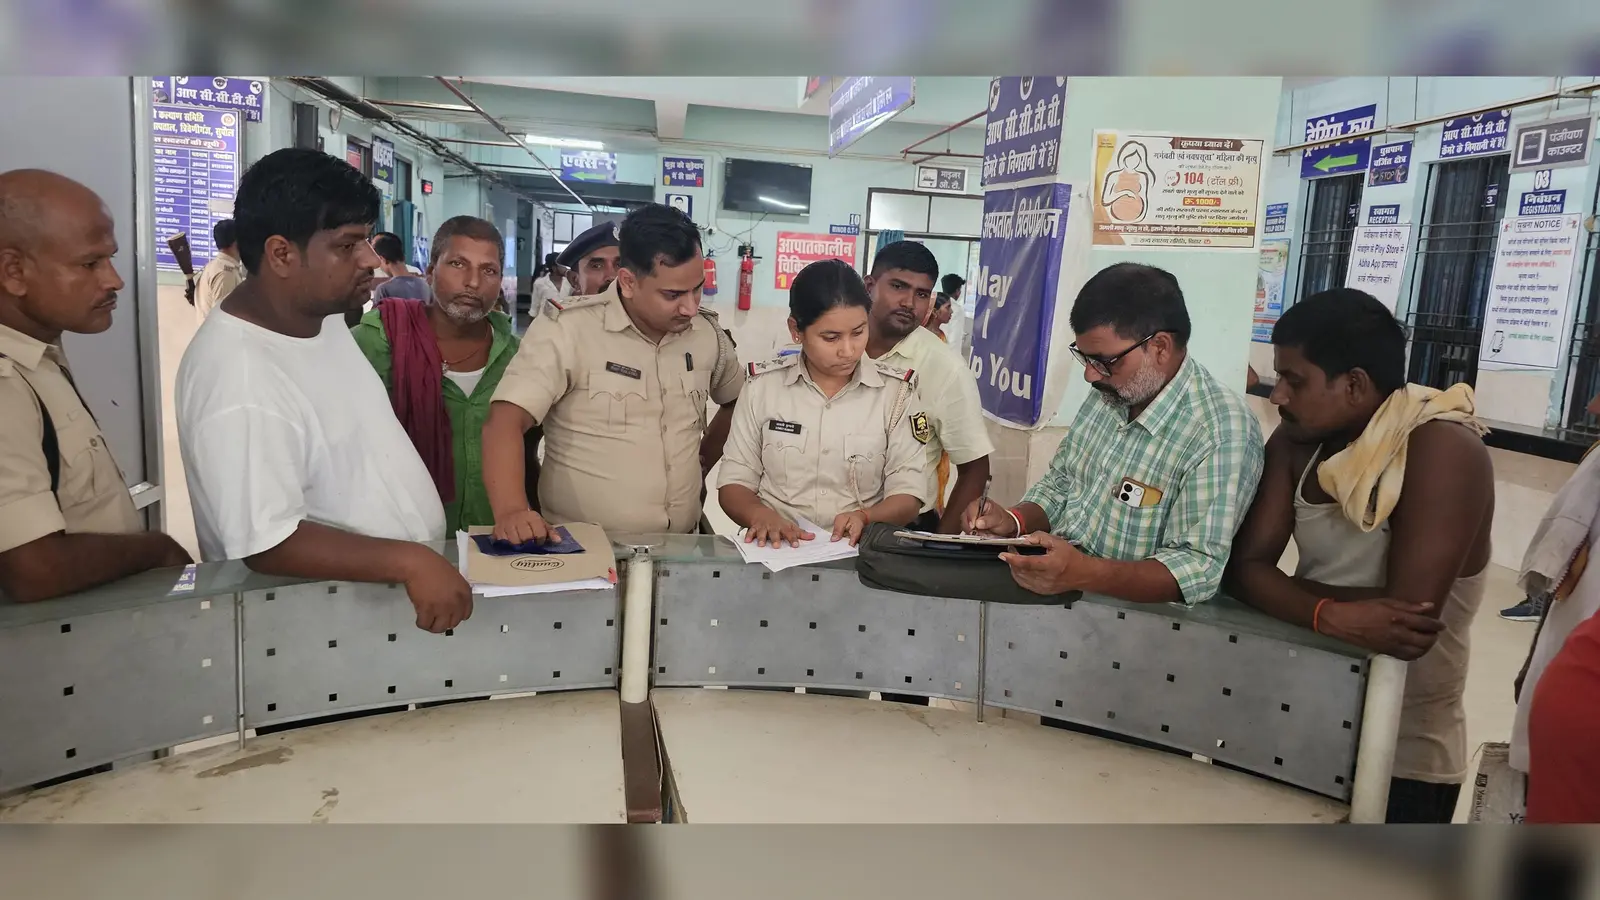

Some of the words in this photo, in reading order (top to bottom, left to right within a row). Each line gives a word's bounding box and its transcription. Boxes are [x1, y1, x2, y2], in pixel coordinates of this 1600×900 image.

[176, 88, 197, 99] आप
[184, 112, 204, 123] समिति
[987, 119, 1004, 146] आप
[1005, 94, 1060, 140] सी.सी.टी.वी.
[154, 122, 178, 133] स्पताल,
[1443, 130, 1459, 141] आप
[1461, 119, 1507, 139] सी.सी.टी.वी.
[1456, 143, 1464, 154] के
[1548, 143, 1583, 157] काउन्टर
[1154, 151, 1175, 160] गर्भवती
[1176, 152, 1185, 160] एवं
[1216, 152, 1235, 163] महिला
[1236, 152, 1244, 162] की
[998, 152, 1007, 176] के
[941, 171, 962, 180] माइनर
[1184, 172, 1204, 185] 104
[1535, 170, 1550, 190] 03
[1525, 193, 1563, 205] निबंधन
[1374, 208, 1396, 216] स्वागत
[1522, 204, 1562, 215] REGISTRATION
[850, 215, 860, 225] 10
[1369, 216, 1398, 224] RECEPTION
[1518, 221, 1533, 231] सूचना
[1534, 220, 1561, 229] NOTICE
[832, 226, 847, 234] MINOR
[778, 237, 854, 257] आपातकालीन
[1375, 244, 1385, 256] Play
[1386, 244, 1400, 254] Store
[1358, 259, 1370, 268] Abha
[1371, 259, 1381, 270] App
[976, 265, 1013, 309] May
[982, 308, 991, 339] I
[990, 352, 1032, 400] You
